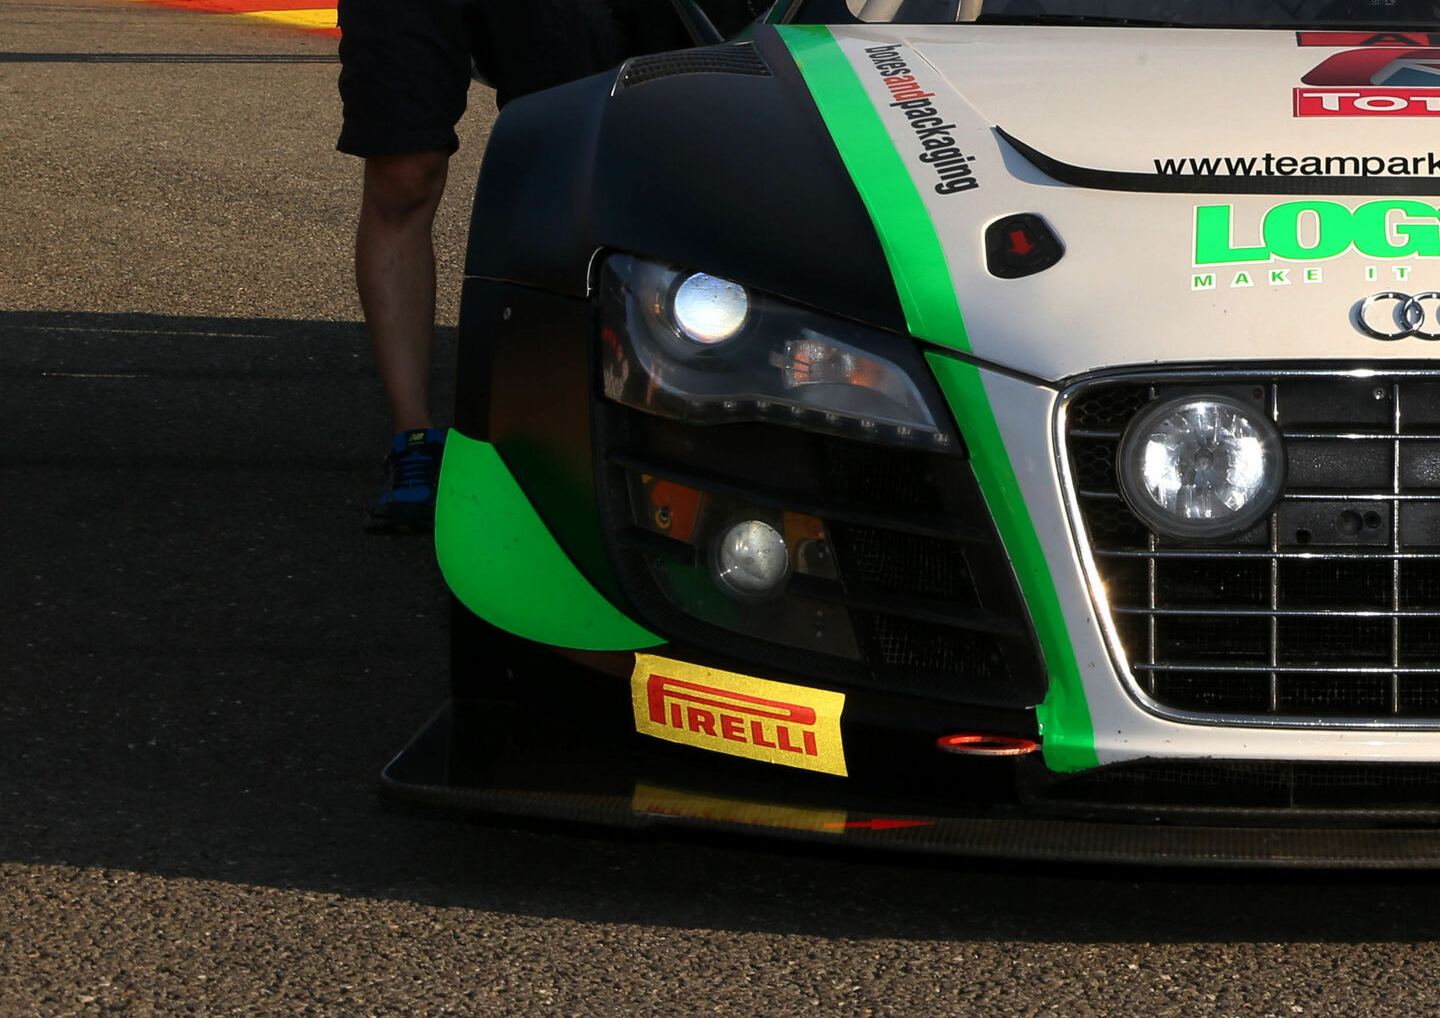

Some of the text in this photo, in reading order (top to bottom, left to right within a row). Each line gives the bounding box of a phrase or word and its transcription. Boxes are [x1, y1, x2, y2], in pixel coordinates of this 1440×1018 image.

[864, 44, 980, 195] boxesandpackaging
[1194, 268, 1320, 288] MAKE
[1368, 266, 1411, 279] IT
[646, 673, 818, 757] PIRELLI
